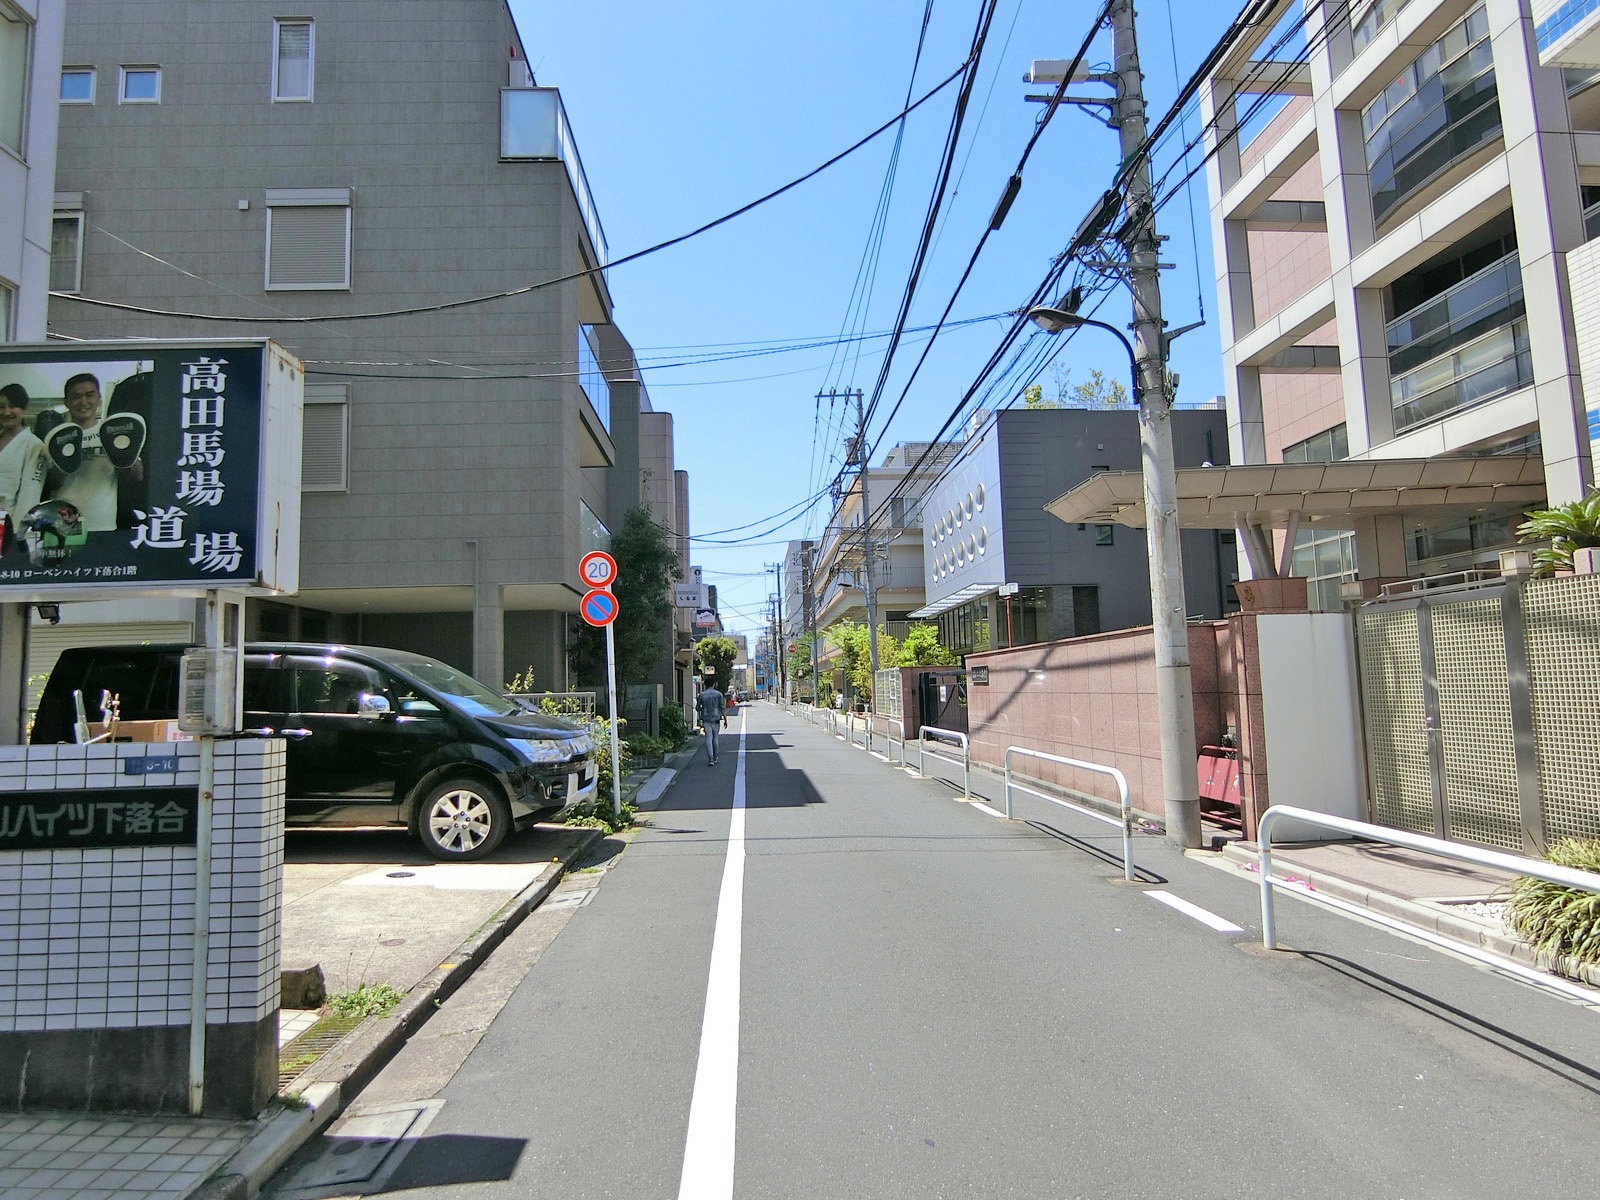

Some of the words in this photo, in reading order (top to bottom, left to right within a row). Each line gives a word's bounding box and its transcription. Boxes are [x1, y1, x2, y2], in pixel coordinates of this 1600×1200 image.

[176, 356, 229, 507] 高田馬場
[130, 505, 243, 573] 道場
[588, 562, 609, 578] 20
